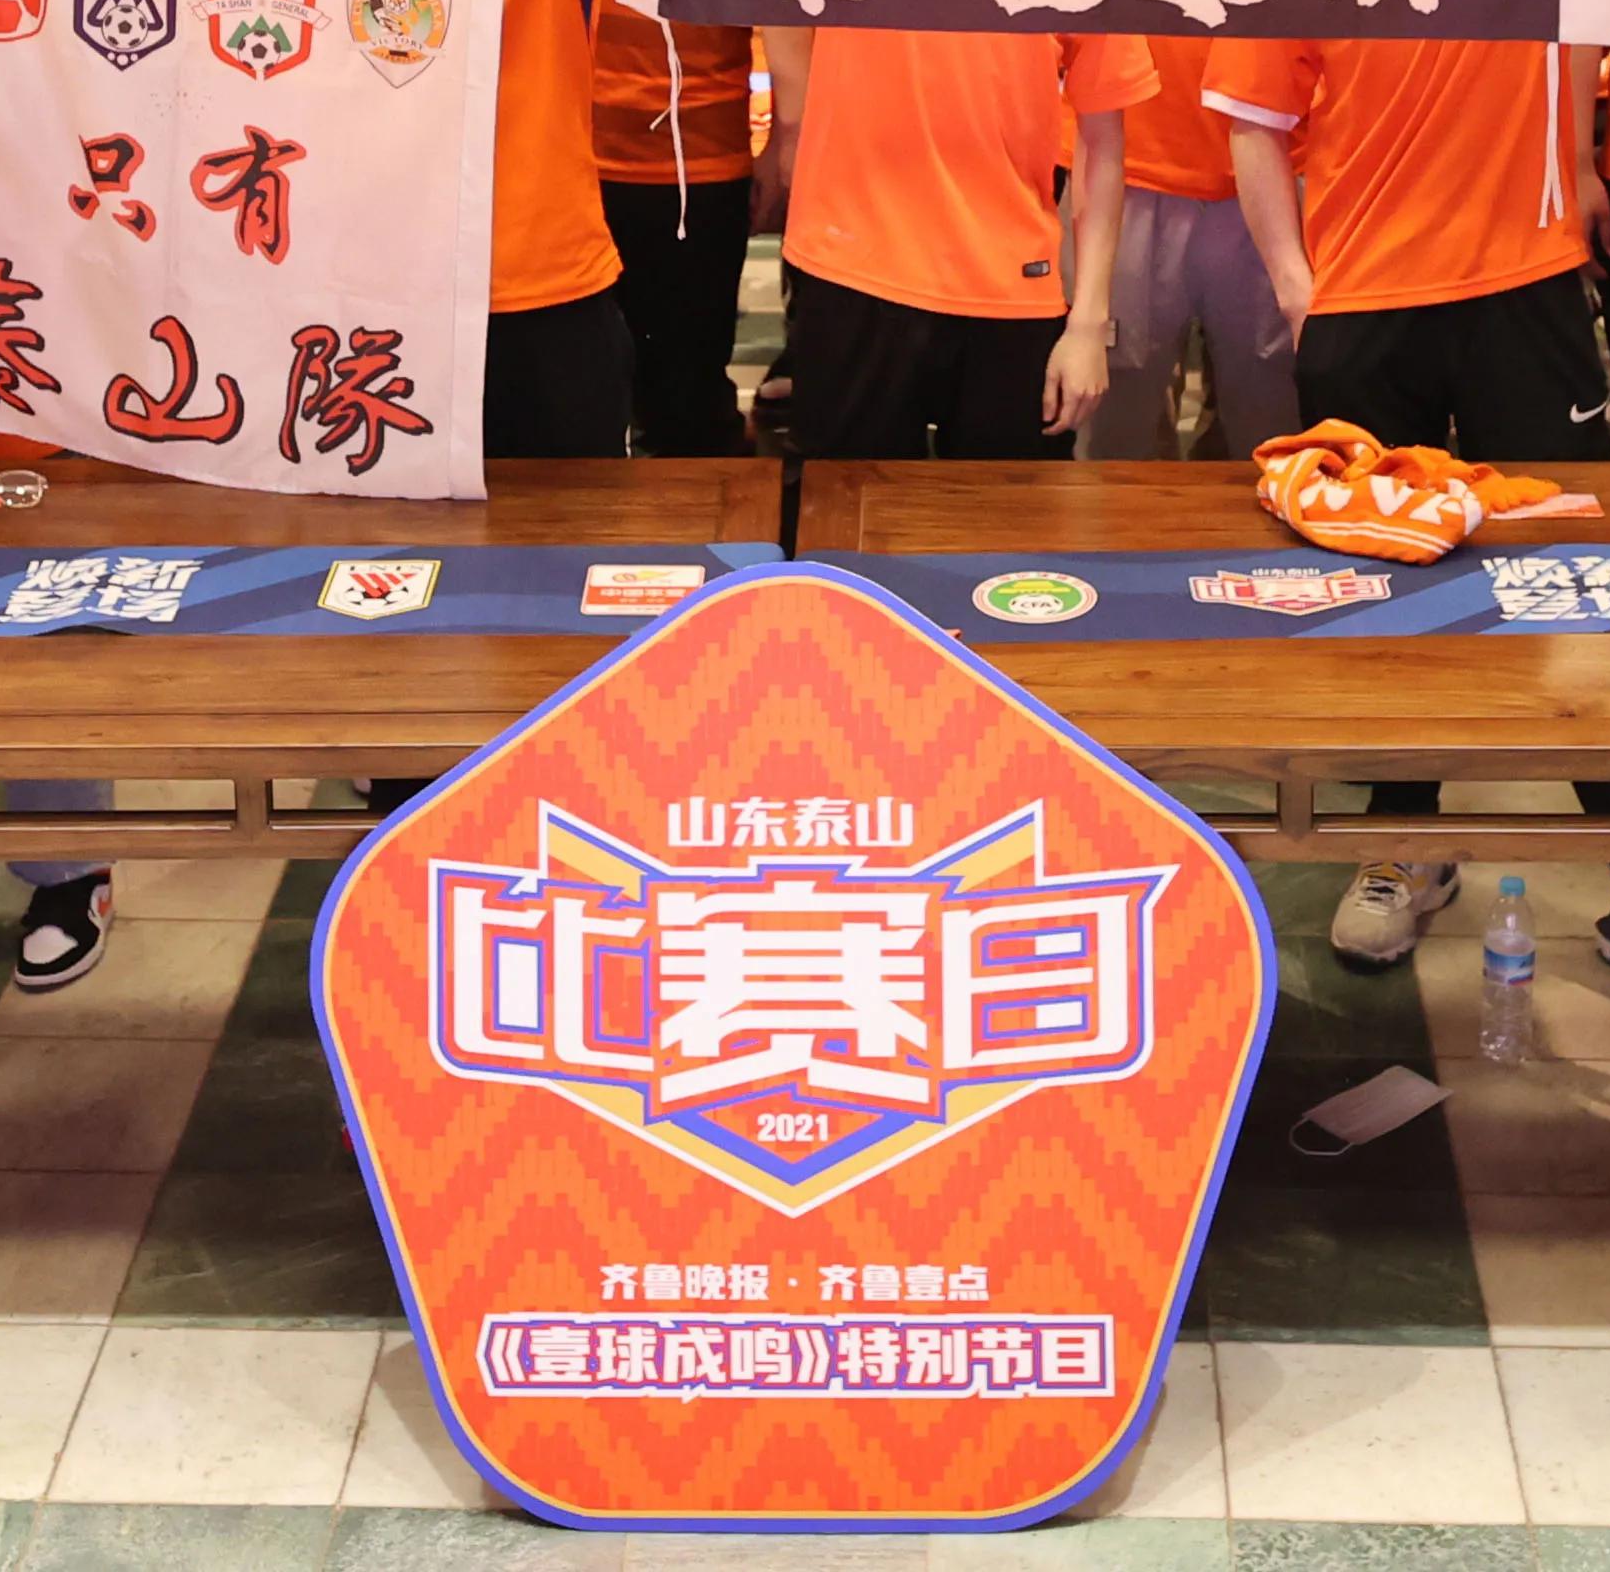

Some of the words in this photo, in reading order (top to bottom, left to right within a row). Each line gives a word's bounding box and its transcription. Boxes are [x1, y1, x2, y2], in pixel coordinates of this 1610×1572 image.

[270, 0, 311, 20] GENERAL
[67, 123, 308, 266] 只有
[24, 556, 204, 591] 焕新
[1193, 576, 1390, 606] 比赛日
[666, 795, 915, 850] 山东泰山
[448, 877, 1132, 1107] 比赛日
[756, 1112, 831, 1145] 2021
[599, 1262, 771, 1303] 齐鲁晚报
[817, 1262, 991, 1303] 齐鲁壹点
[486, 1322, 1108, 1388] 《壹球成鸣》特别节目
